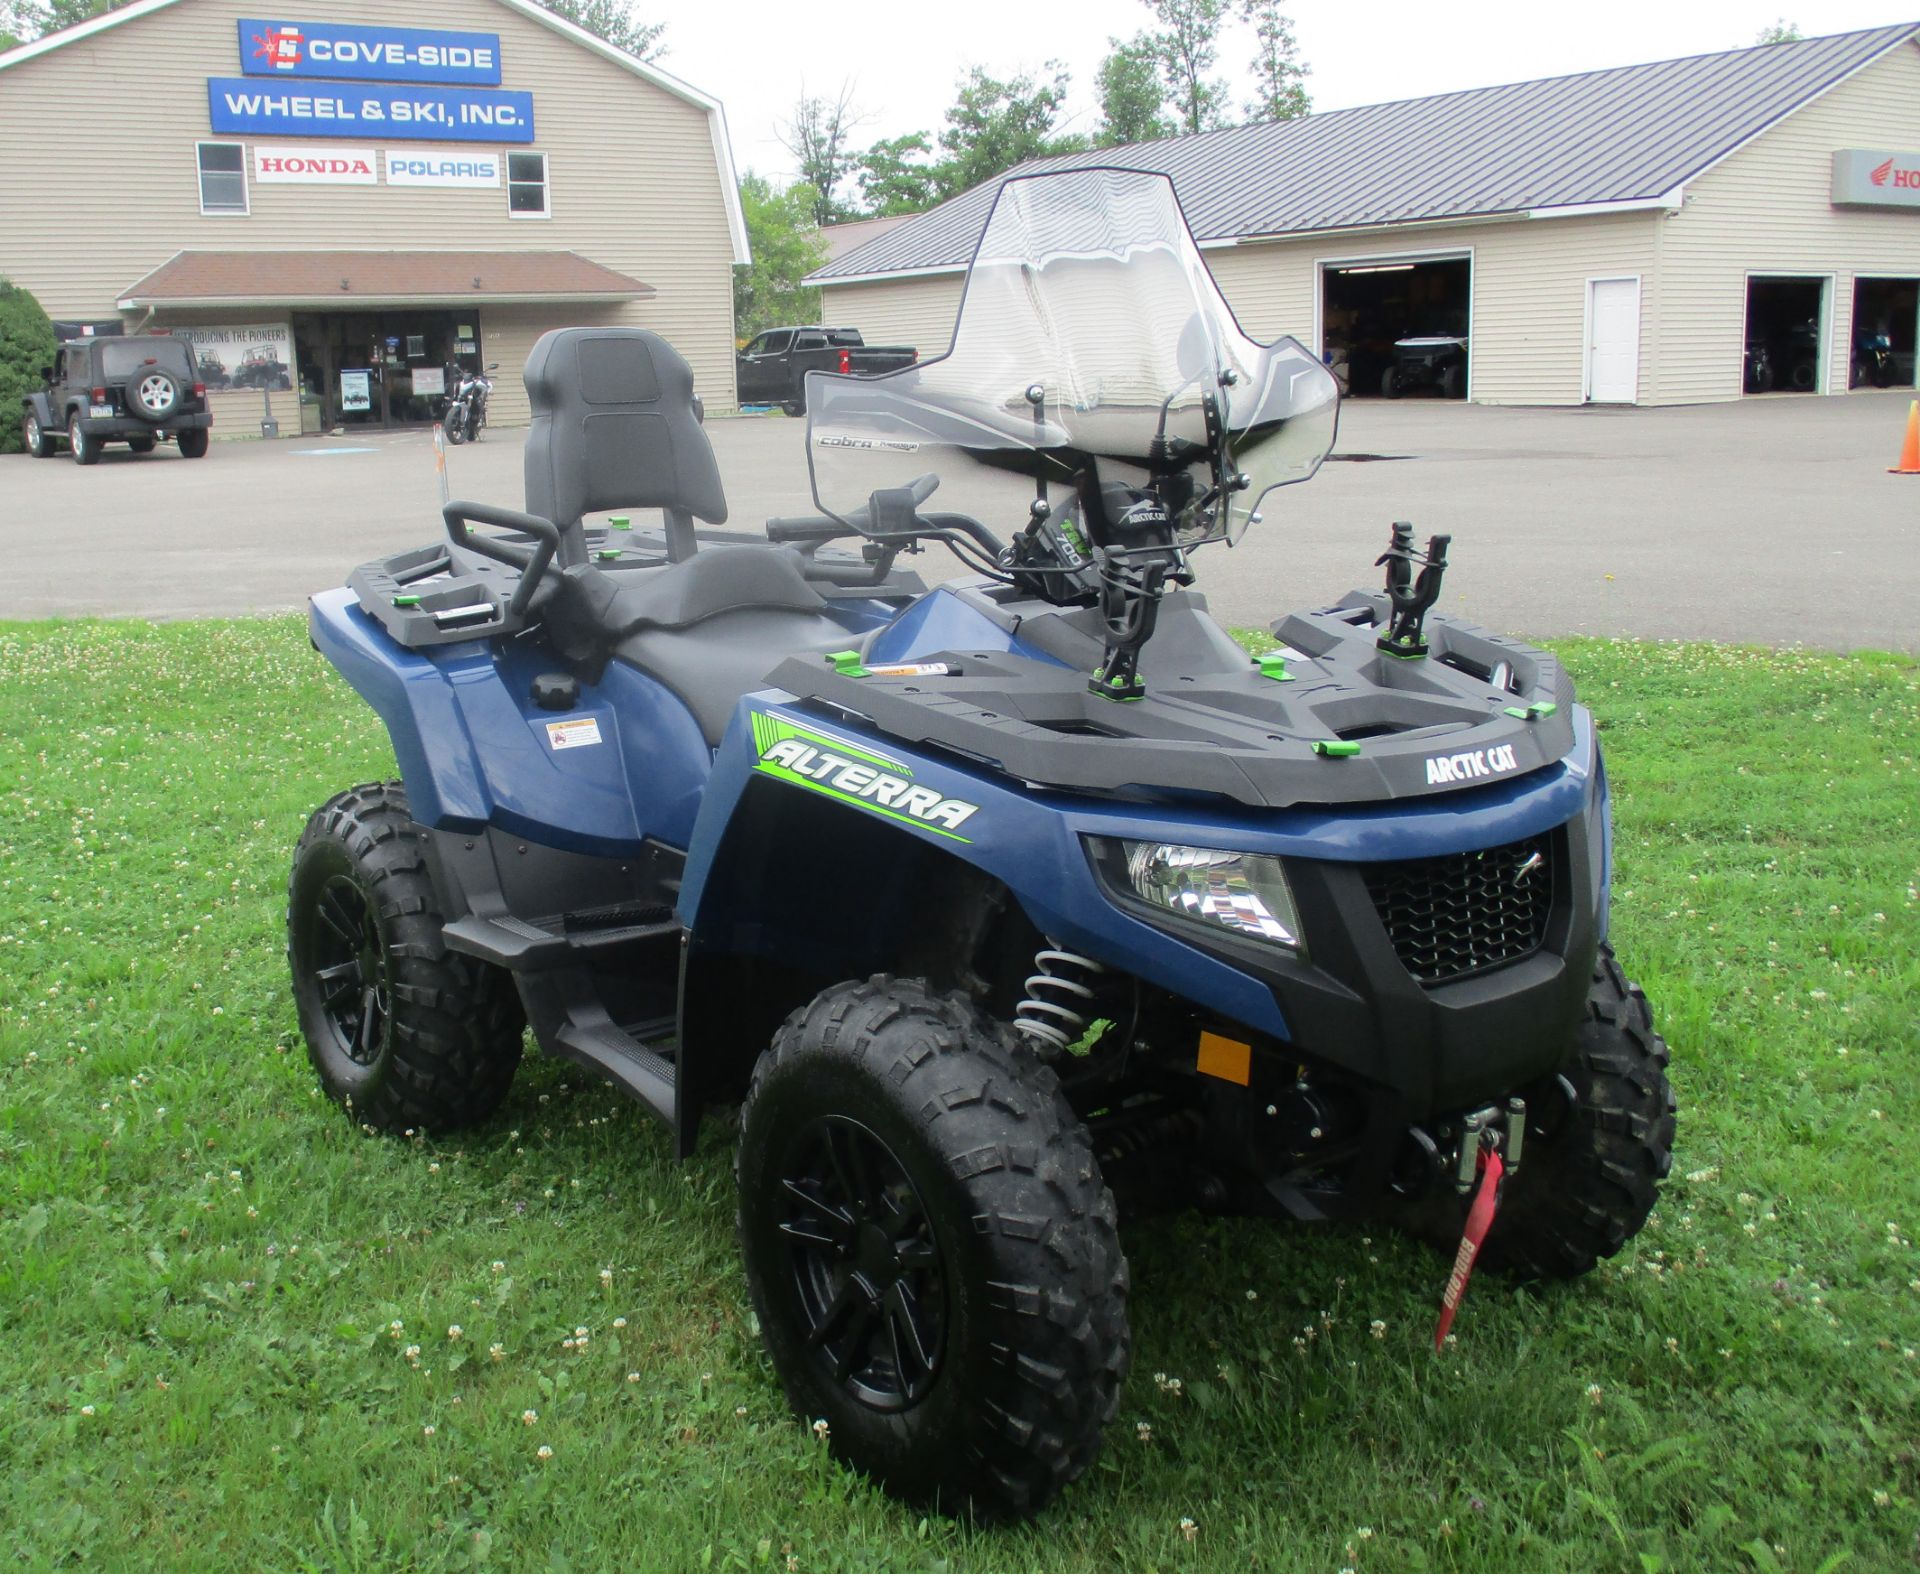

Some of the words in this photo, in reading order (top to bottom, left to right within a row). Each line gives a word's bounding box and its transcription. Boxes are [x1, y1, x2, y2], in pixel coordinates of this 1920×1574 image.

[309, 40, 493, 69] COVE-SIDE
[225, 93, 355, 119] WHEEL
[361, 100, 385, 120] &
[391, 101, 455, 127] SKI,
[461, 104, 525, 126] INC.
[260, 157, 372, 175] HONDA
[390, 160, 495, 177] POLARIS
[232, 329, 247, 342] THE
[1128, 512, 1156, 524] ARCTIC
[1056, 533, 1082, 566] 700
[1425, 750, 1490, 785] ARCTIC
[1487, 744, 1518, 772] CAT
[761, 738, 979, 829] ALTERRA
[1443, 1236, 1476, 1309] BADLAND
